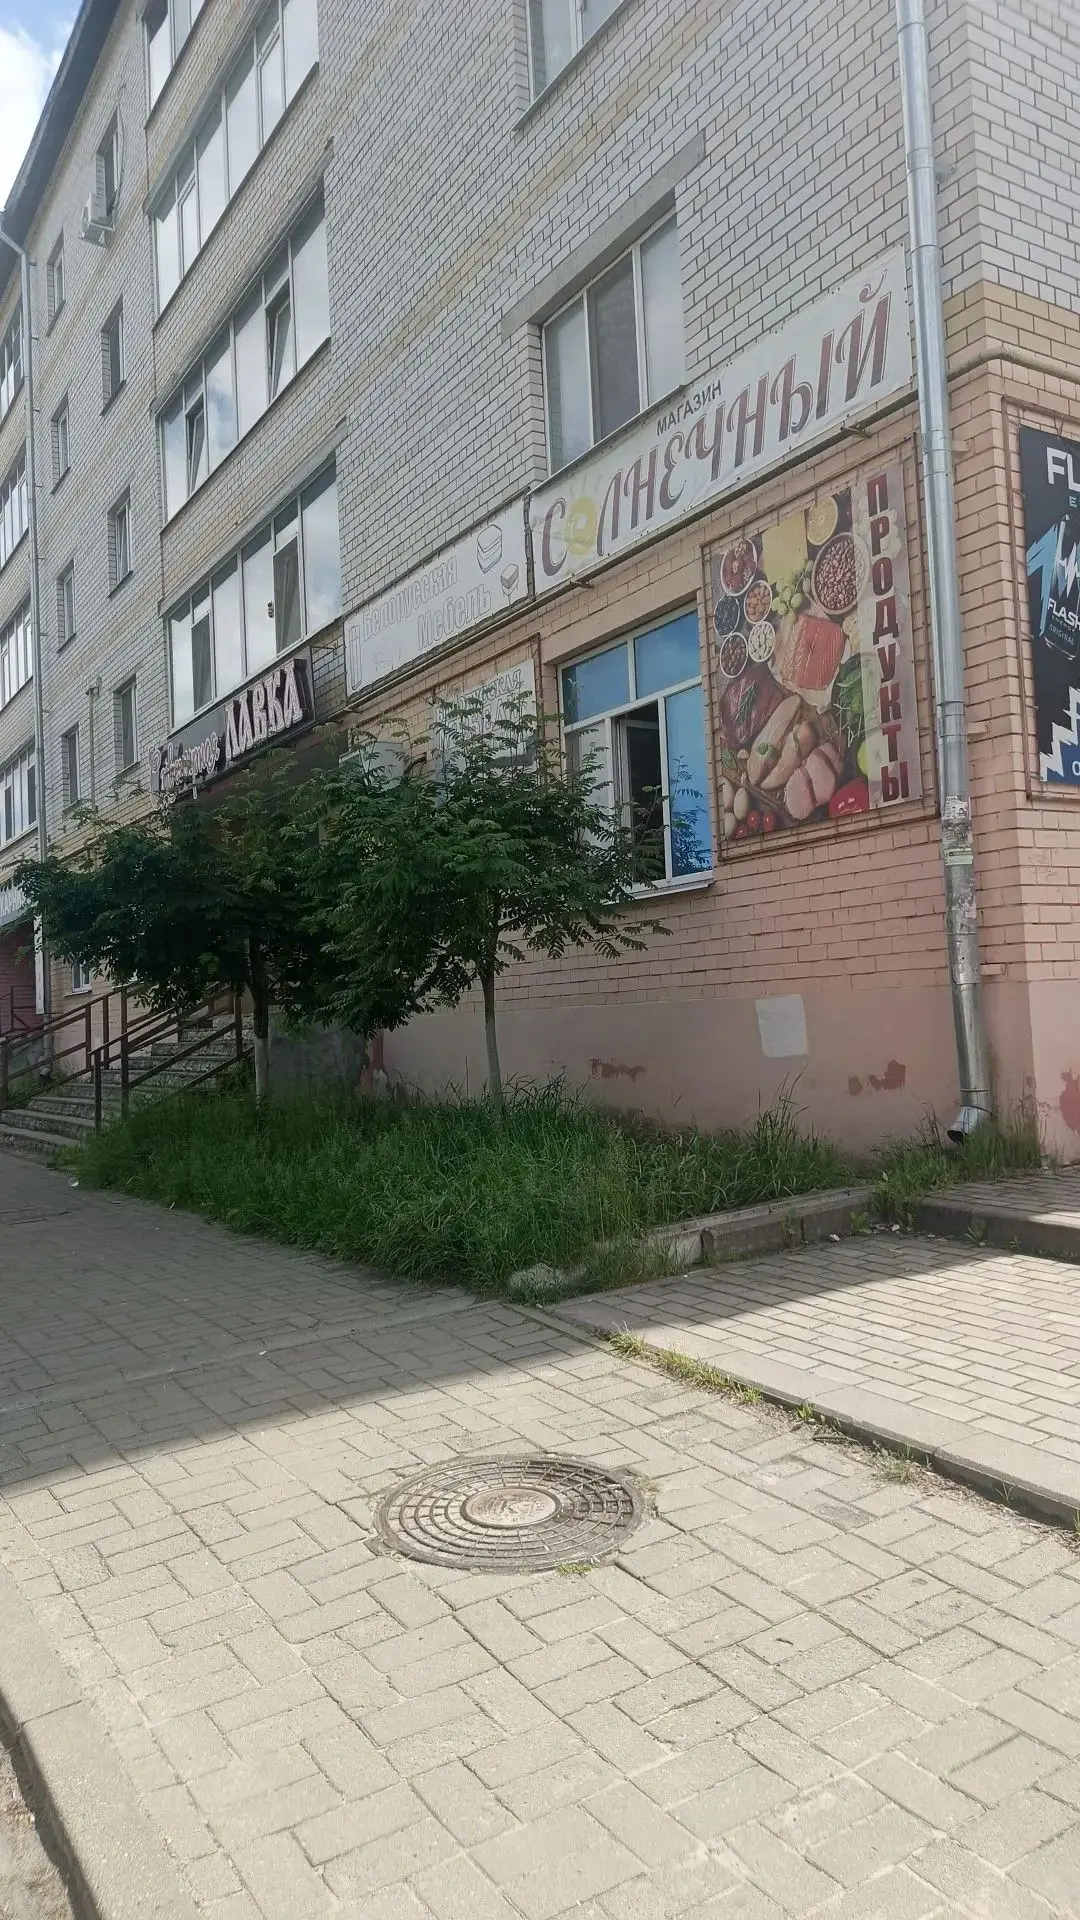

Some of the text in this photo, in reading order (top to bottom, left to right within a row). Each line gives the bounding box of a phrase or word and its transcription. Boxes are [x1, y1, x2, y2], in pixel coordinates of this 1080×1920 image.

[541, 269, 892, 577] СОЛНЕЧНЫЙ
[656, 378, 722, 437] МАГАЗИН
[362, 553, 458, 642] Белорусская
[417, 583, 492, 651] Мебель
[866, 473, 909, 803] ПРОДУКТЫ
[1047, 597, 1080, 632] FLASH
[225, 658, 304, 761] ЛАВКА
